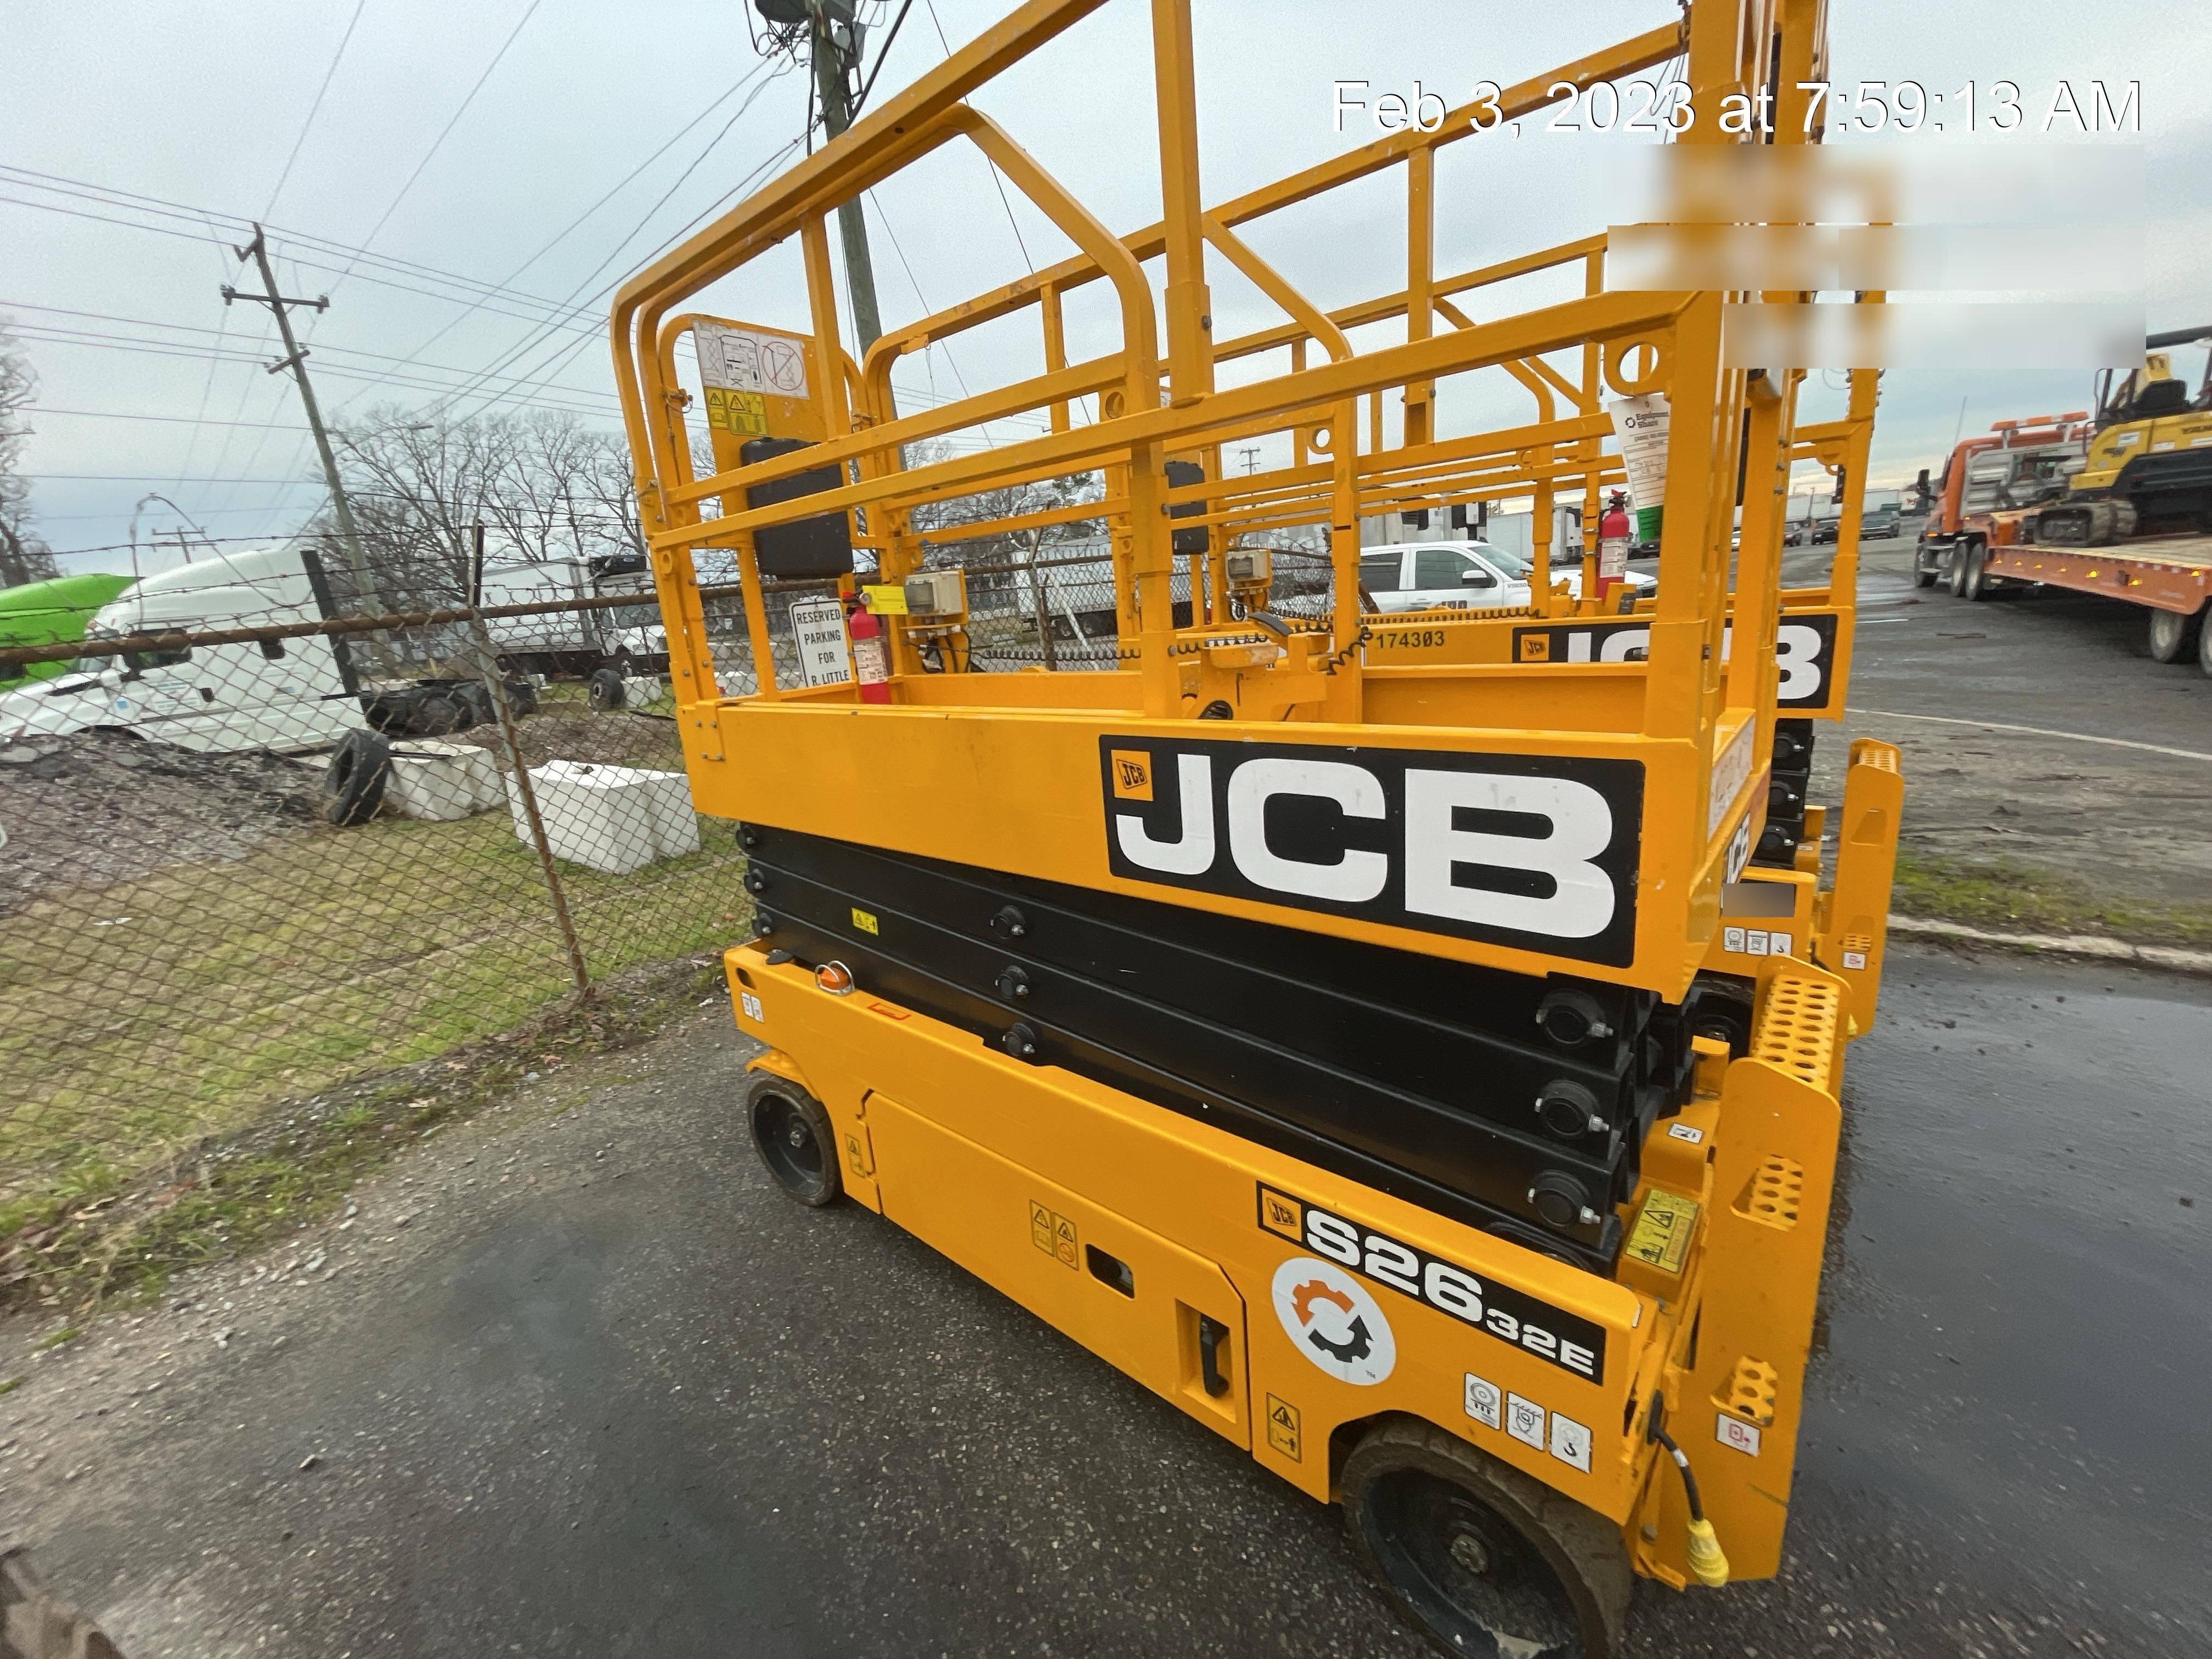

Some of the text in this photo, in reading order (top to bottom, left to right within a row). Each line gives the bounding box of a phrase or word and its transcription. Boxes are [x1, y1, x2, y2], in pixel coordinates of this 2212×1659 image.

[796, 609, 840, 624] RESERVED
[804, 630, 842, 645] PARKING
[1376, 631, 1445, 648] 174303
[818, 651, 835, 664] FOR
[822, 670, 849, 684] LITTLE
[1122, 763, 1145, 786] JCB
[1116, 754, 1615, 938] JCB
[1272, 1202, 1295, 1224] JCB
